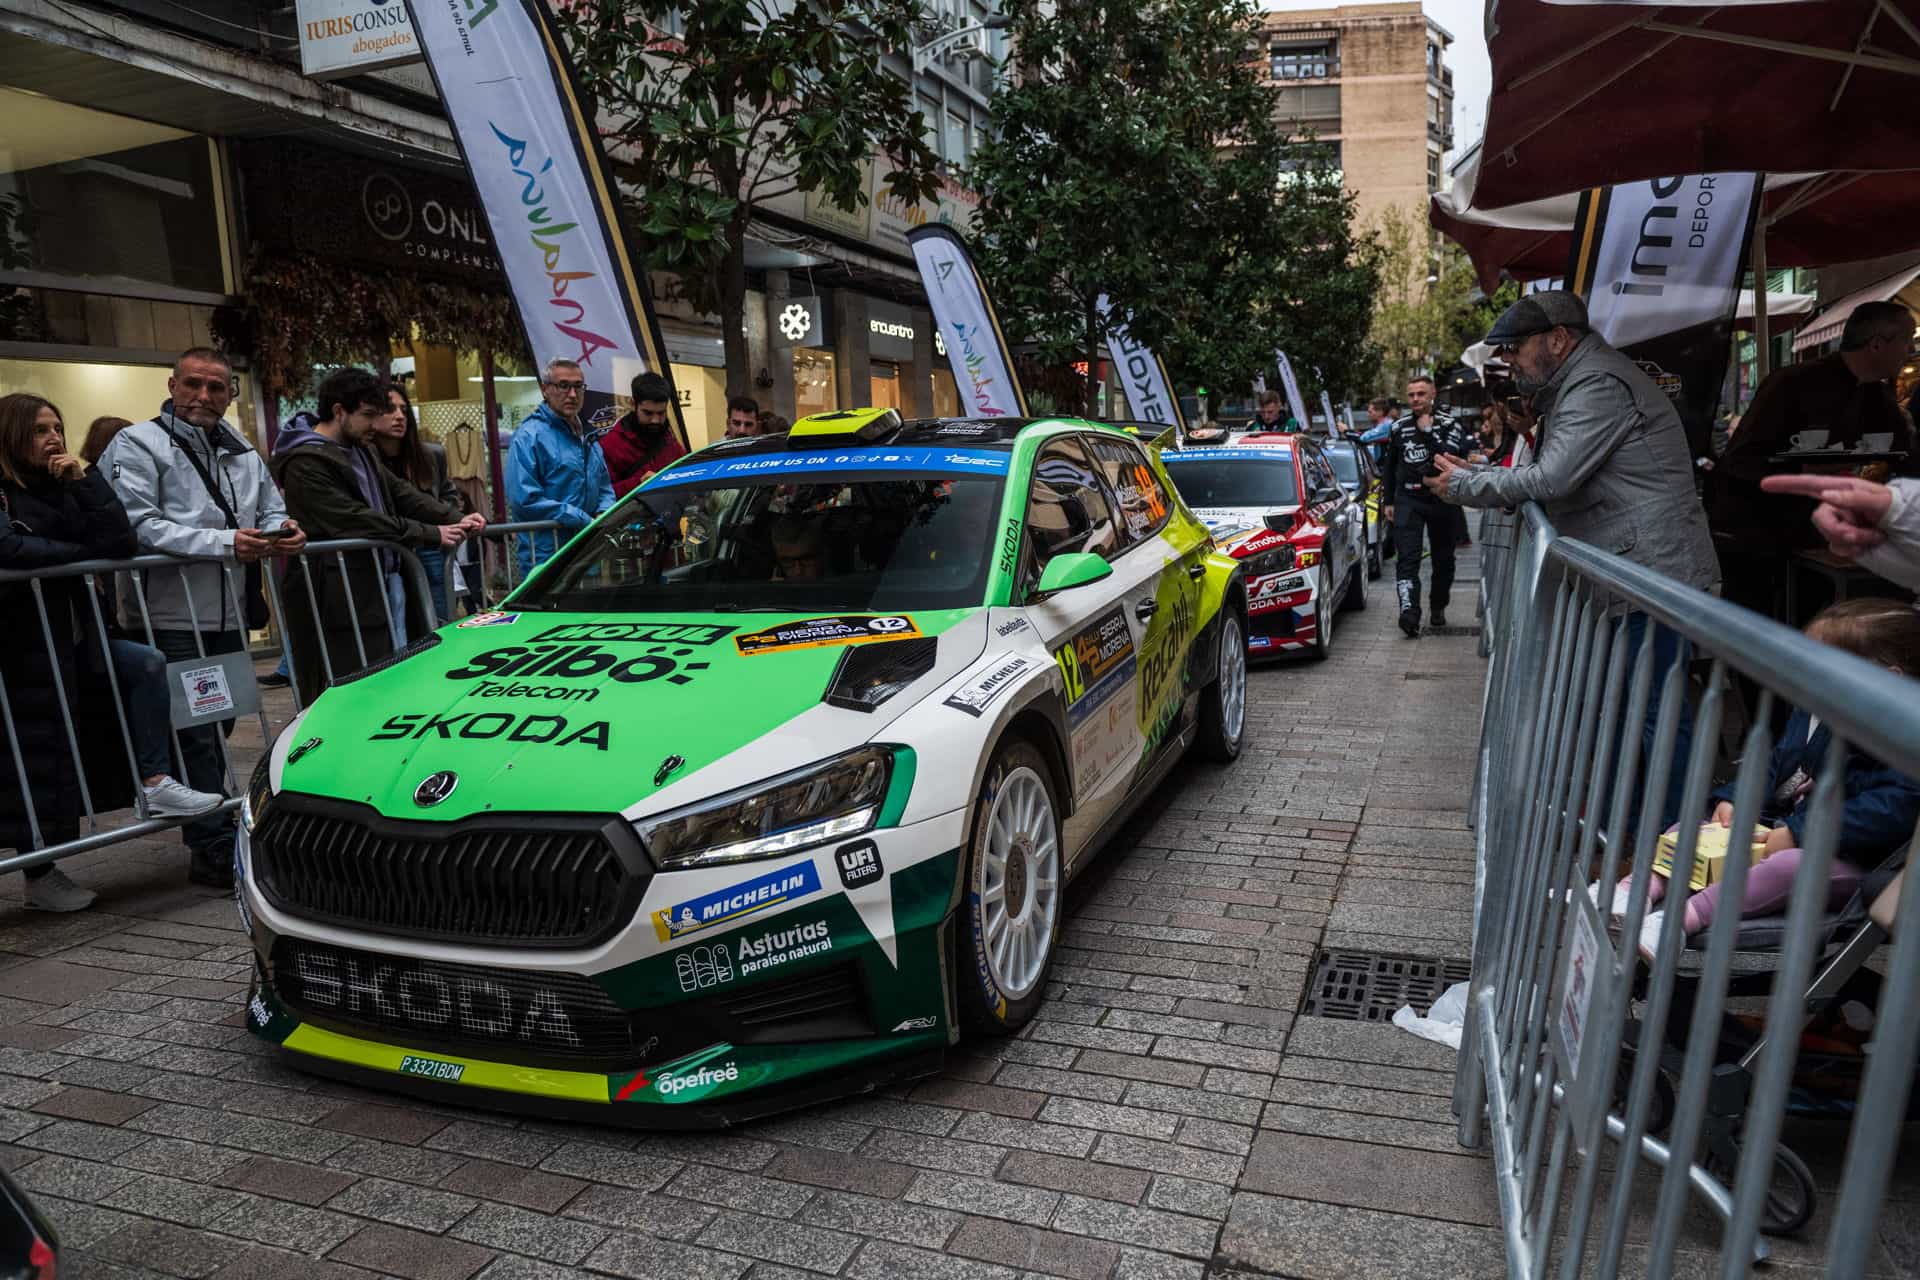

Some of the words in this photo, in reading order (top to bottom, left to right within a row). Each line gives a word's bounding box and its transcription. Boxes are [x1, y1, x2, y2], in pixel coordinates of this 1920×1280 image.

[352, 31, 412, 54] abogados
[1688, 173, 1718, 248] DEPOR
[870, 320, 914, 339] encuentro
[727, 459, 783, 471] FOLLOW
[784, 458, 804, 466] US
[806, 456, 828, 465] ON
[875, 619, 902, 628] 12
[1100, 612, 1126, 640] SIERRA
[1100, 630, 1131, 661] MORENA
[979, 659, 1028, 691] MICHELIN
[1056, 643, 1084, 704] 12
[468, 681, 600, 702] Telecom
[841, 847, 873, 870] UFI
[846, 863, 878, 881] FILTERS
[703, 874, 804, 921] MICHELIN
[738, 920, 829, 960] Asturias
[741, 952, 788, 976] paraíso
[789, 937, 833, 961] natural
